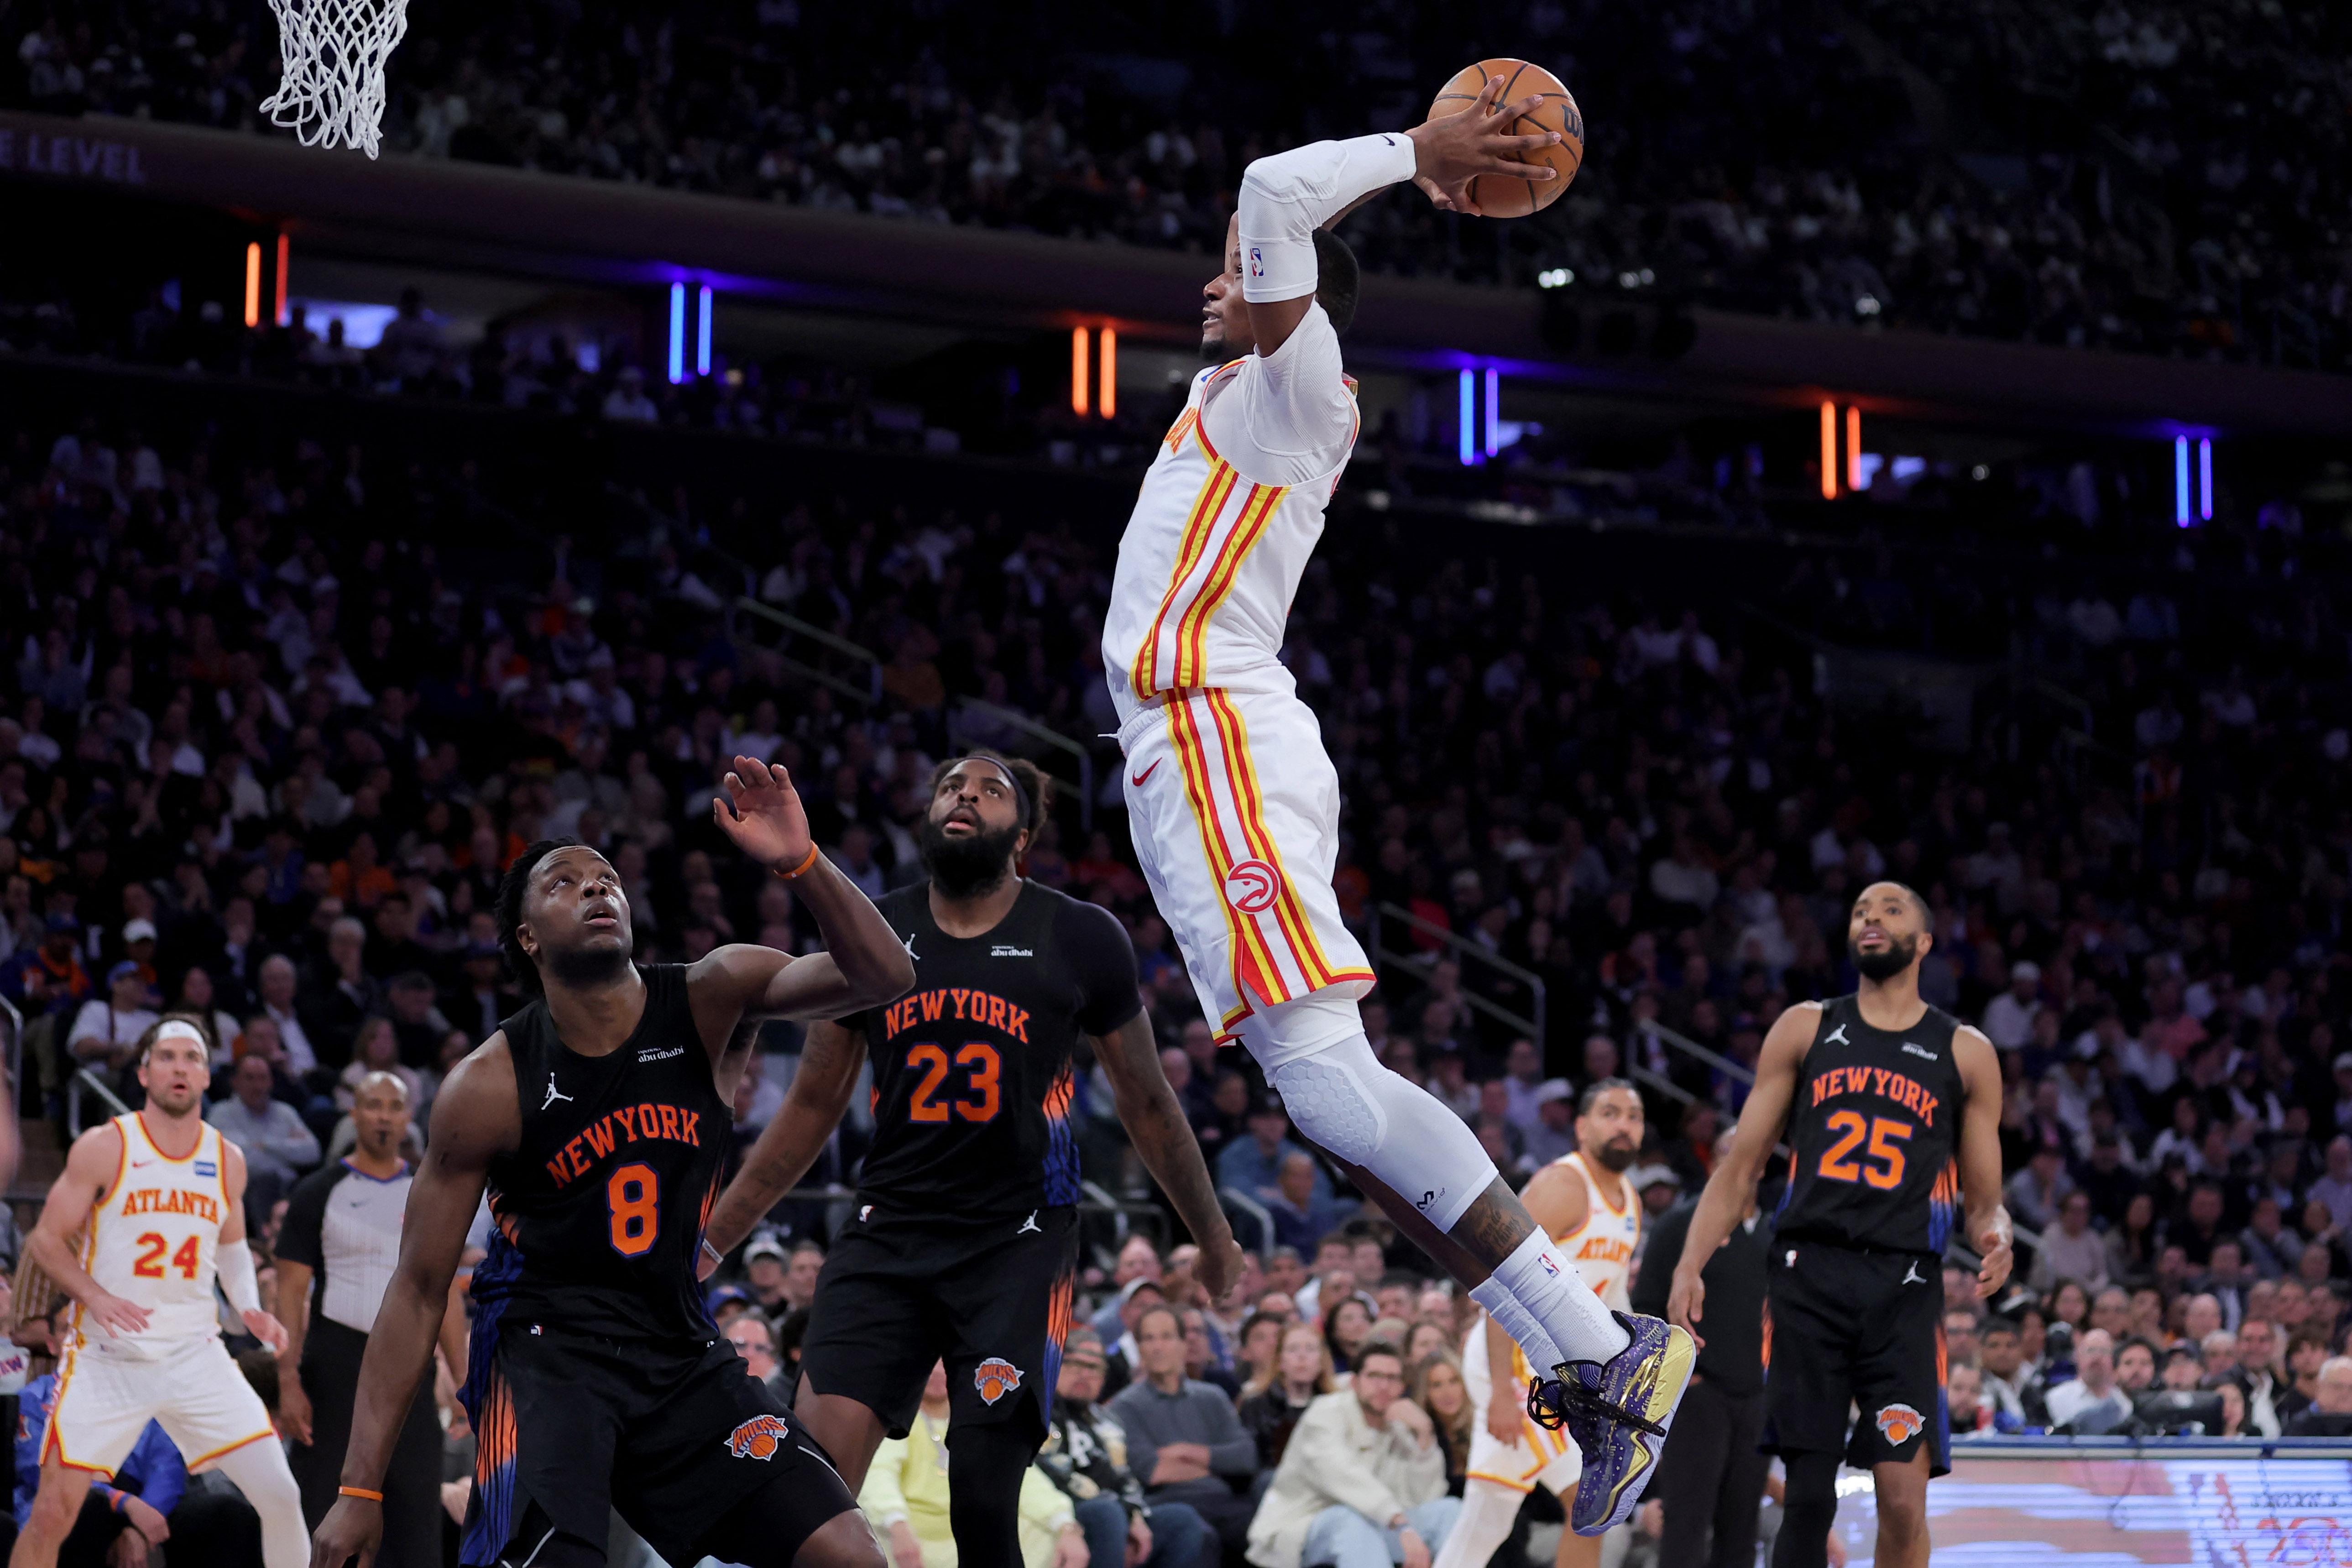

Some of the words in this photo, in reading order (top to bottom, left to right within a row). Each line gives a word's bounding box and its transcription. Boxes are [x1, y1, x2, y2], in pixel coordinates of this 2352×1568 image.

[28, 134, 146, 184] LEVEL
[885, 989, 948, 1041] NEW
[951, 989, 1030, 1044] YORK
[638, 1053, 657, 1063] abu
[657, 1045, 684, 1059] dhabi
[907, 1043, 1000, 1122] 23
[1812, 1067, 1872, 1108] NEW
[1874, 1069, 1939, 1128] YORK
[546, 1115, 615, 1189] NEW
[613, 1103, 700, 1147] YORK
[1818, 1110, 1913, 1190] 25
[121, 1188, 219, 1226] ATLANTA
[607, 1162, 659, 1257] 8
[133, 1232, 201, 1281] 24
[977, 1364, 1018, 1385] KNICKS
[733, 1416, 786, 1454] KNICKS
